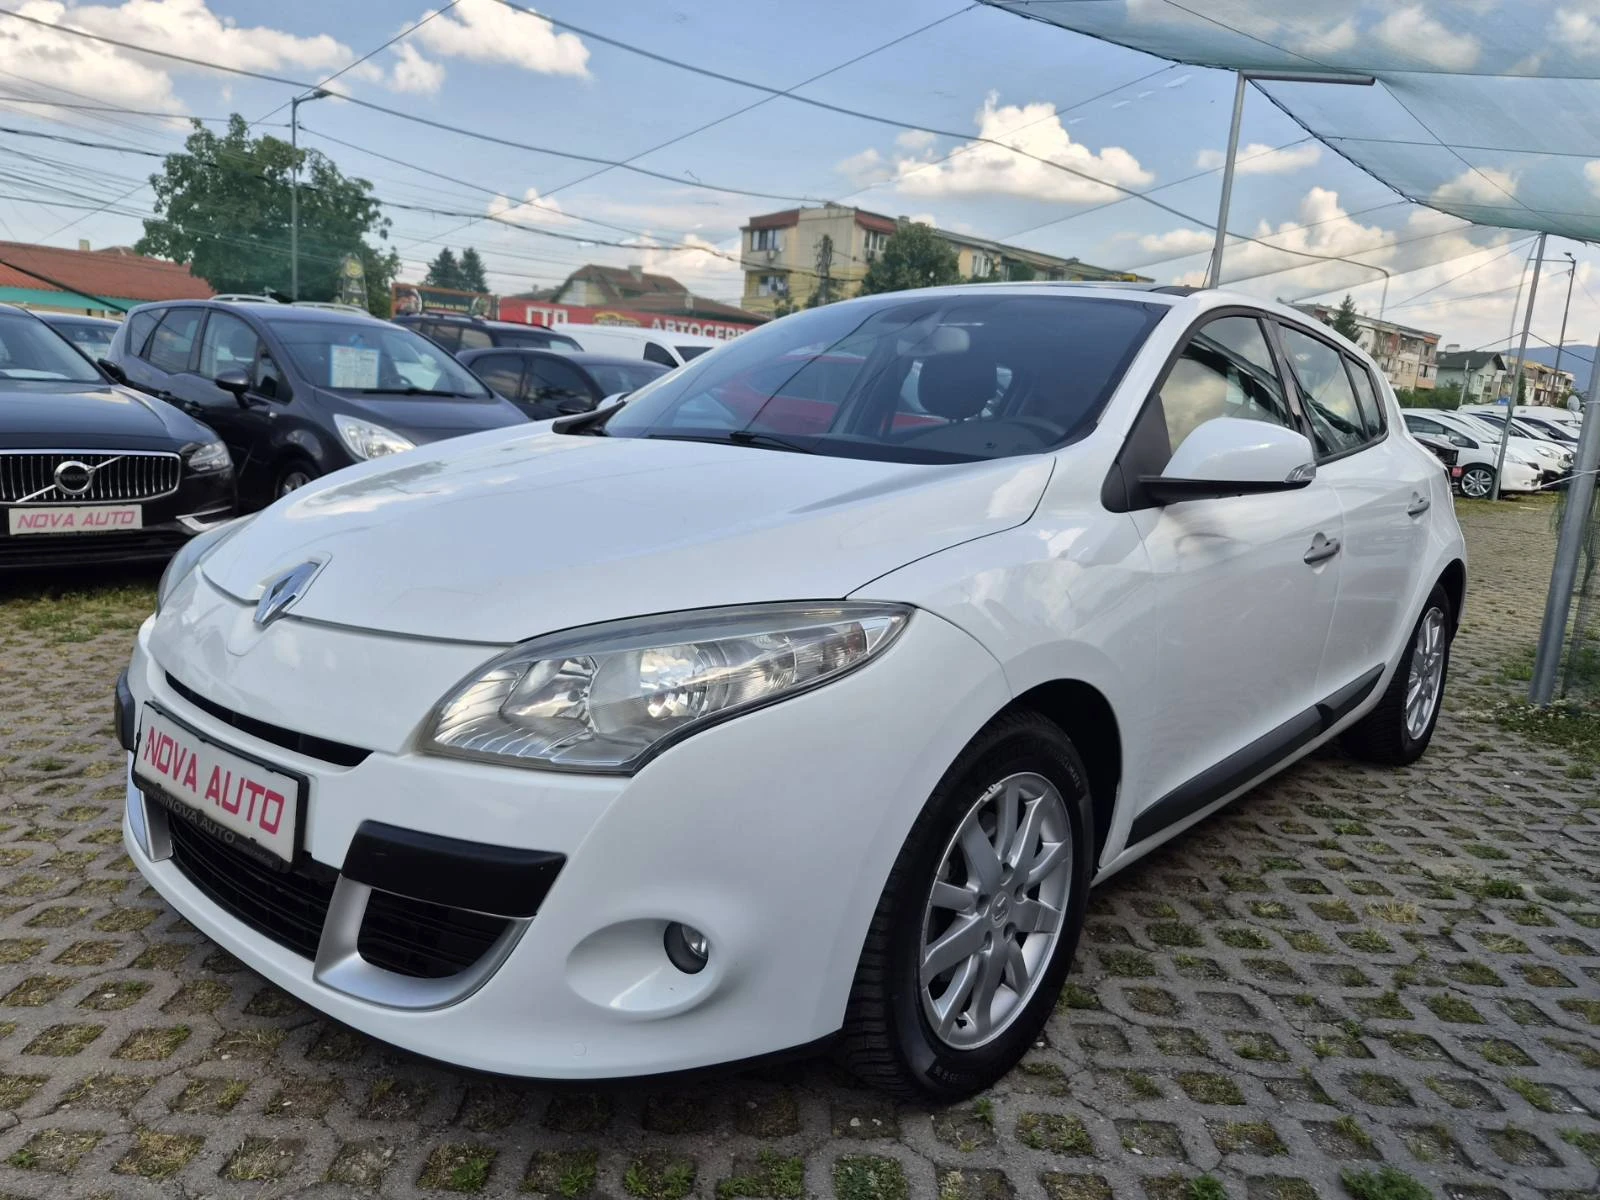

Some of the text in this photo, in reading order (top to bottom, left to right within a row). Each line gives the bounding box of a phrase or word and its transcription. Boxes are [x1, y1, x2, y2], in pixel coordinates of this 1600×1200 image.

[17, 510, 136, 529] NOVA AUTO
[143, 725, 286, 836] NOVA AUTO
[165, 799, 236, 844] NOVA AUTO
